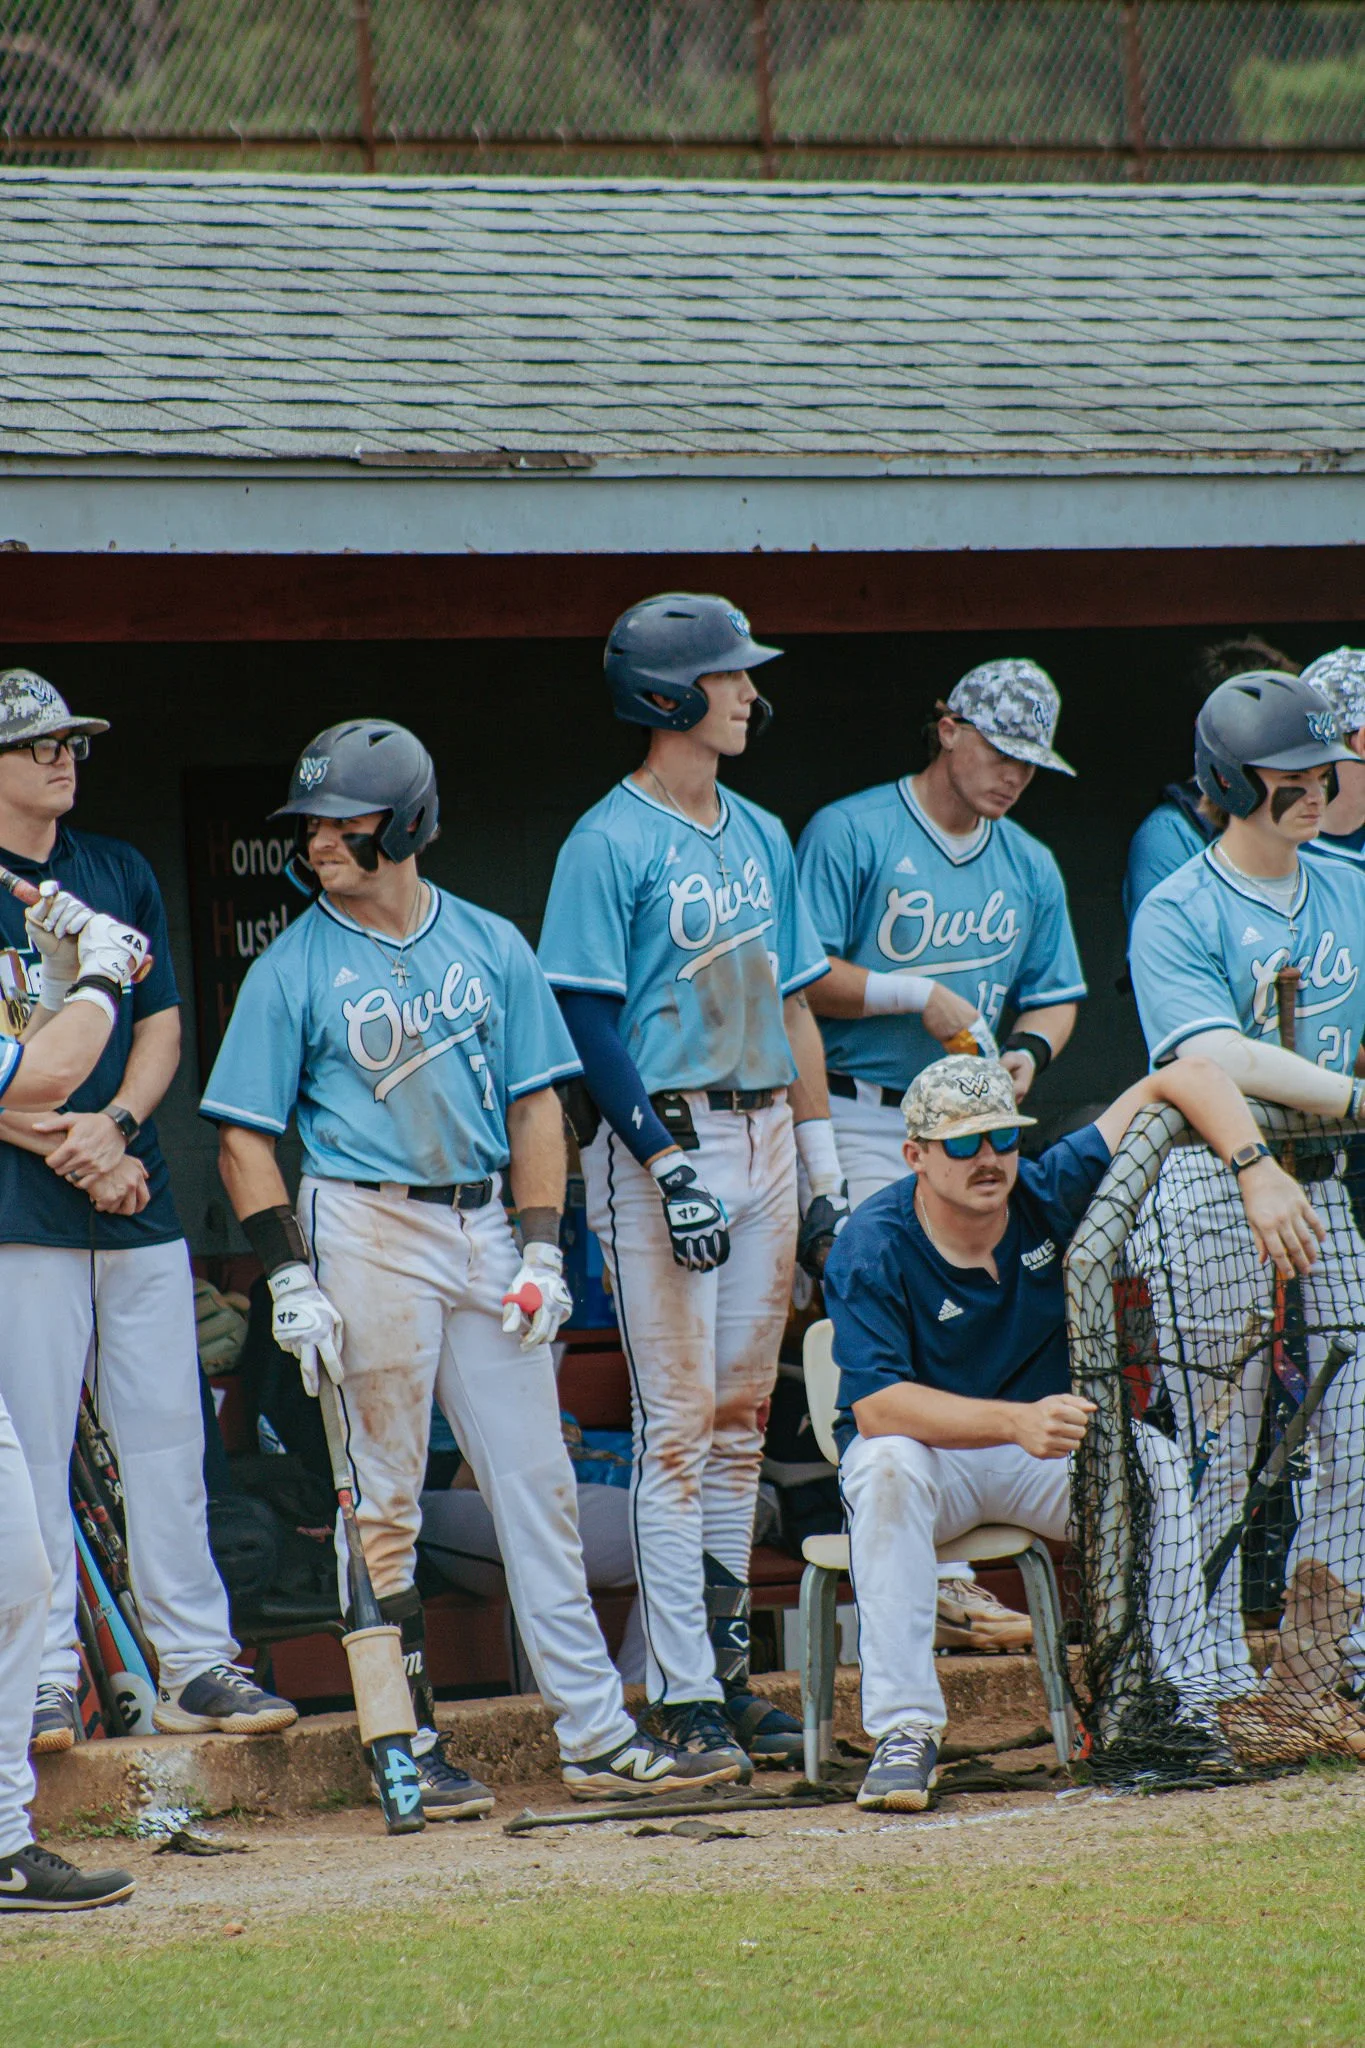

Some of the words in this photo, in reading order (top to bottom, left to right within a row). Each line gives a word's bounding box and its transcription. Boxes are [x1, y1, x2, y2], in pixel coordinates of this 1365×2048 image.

[667, 856, 773, 951] Owls
[876, 887, 1020, 963] Owls
[341, 961, 491, 1073] Owls
[976, 980, 1009, 1028] 15
[1316, 1024, 1353, 1076] 21
[1020, 1238, 1056, 1267] OWLS
[384, 1748, 421, 1816] 44
